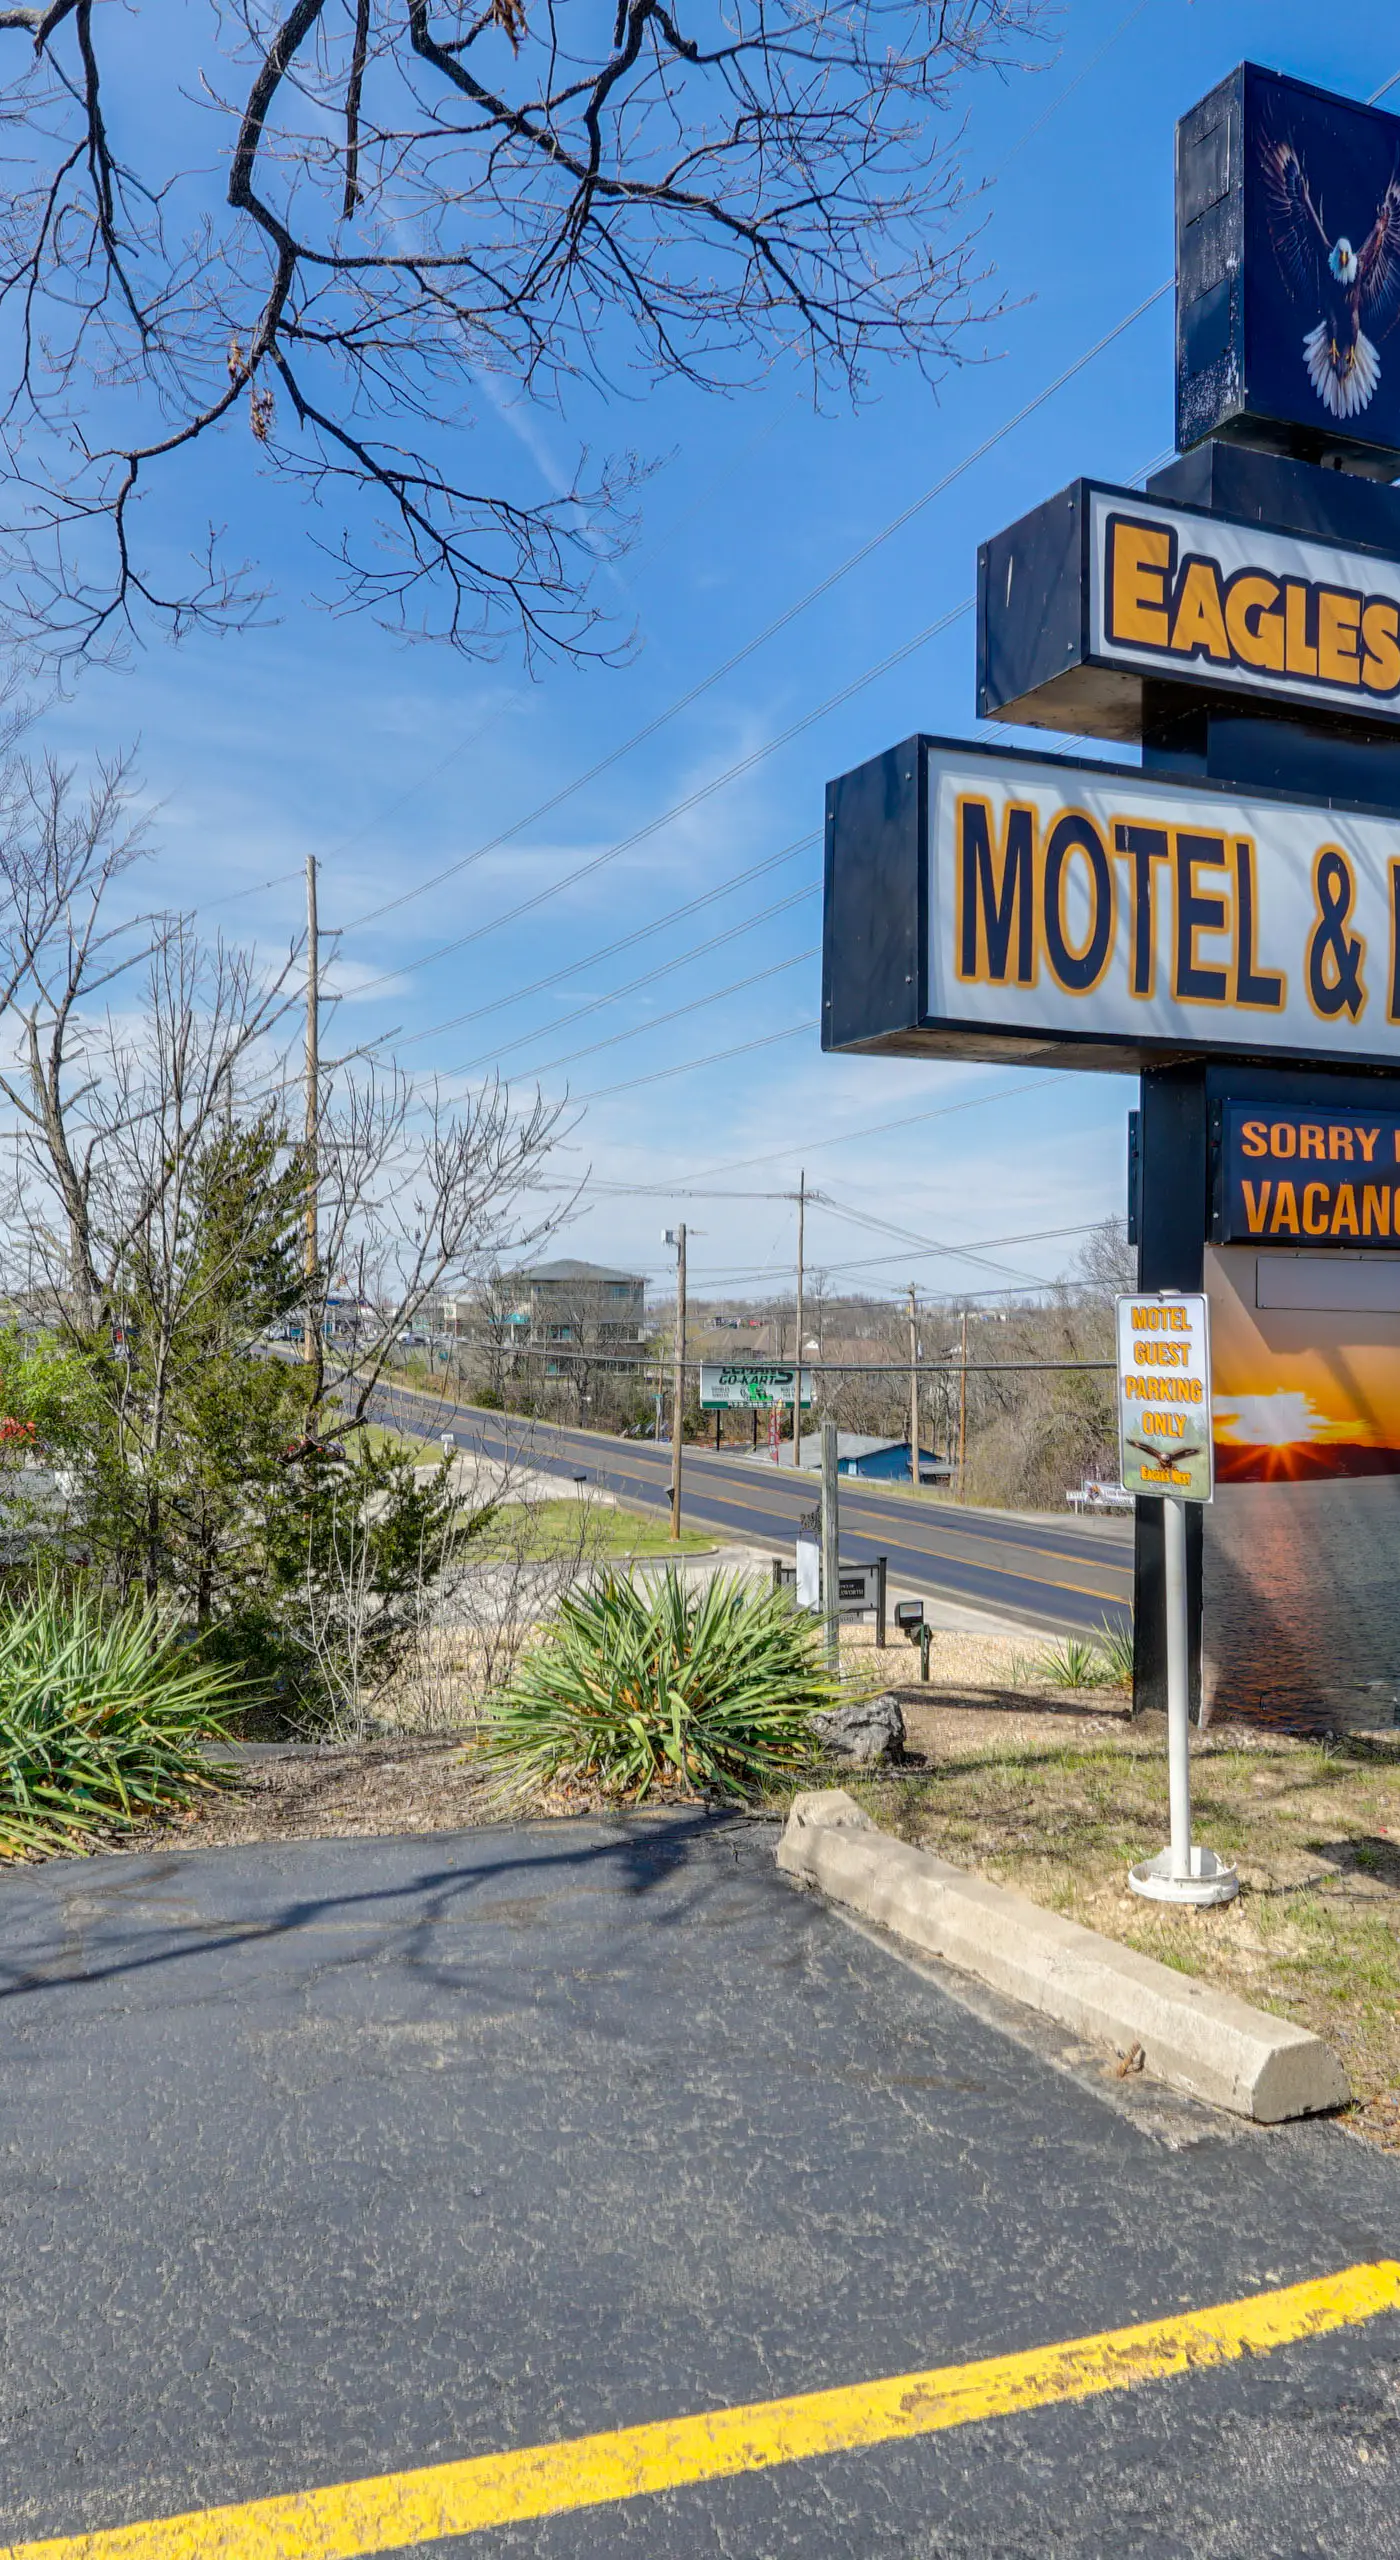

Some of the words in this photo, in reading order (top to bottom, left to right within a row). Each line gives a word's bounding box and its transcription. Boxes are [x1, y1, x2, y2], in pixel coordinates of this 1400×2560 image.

[956, 794, 1286, 1012] MOTEL
[1309, 844, 1367, 1024] &
[1241, 1121, 1381, 1162] SORRY
[1241, 1180, 1400, 1236] VACAN
[1131, 1306, 1193, 1331] MOTEL
[1134, 1341, 1192, 1367] GUEST
[1125, 1375, 1202, 1404] PARKING
[1142, 1410, 1188, 1438] ONLY
